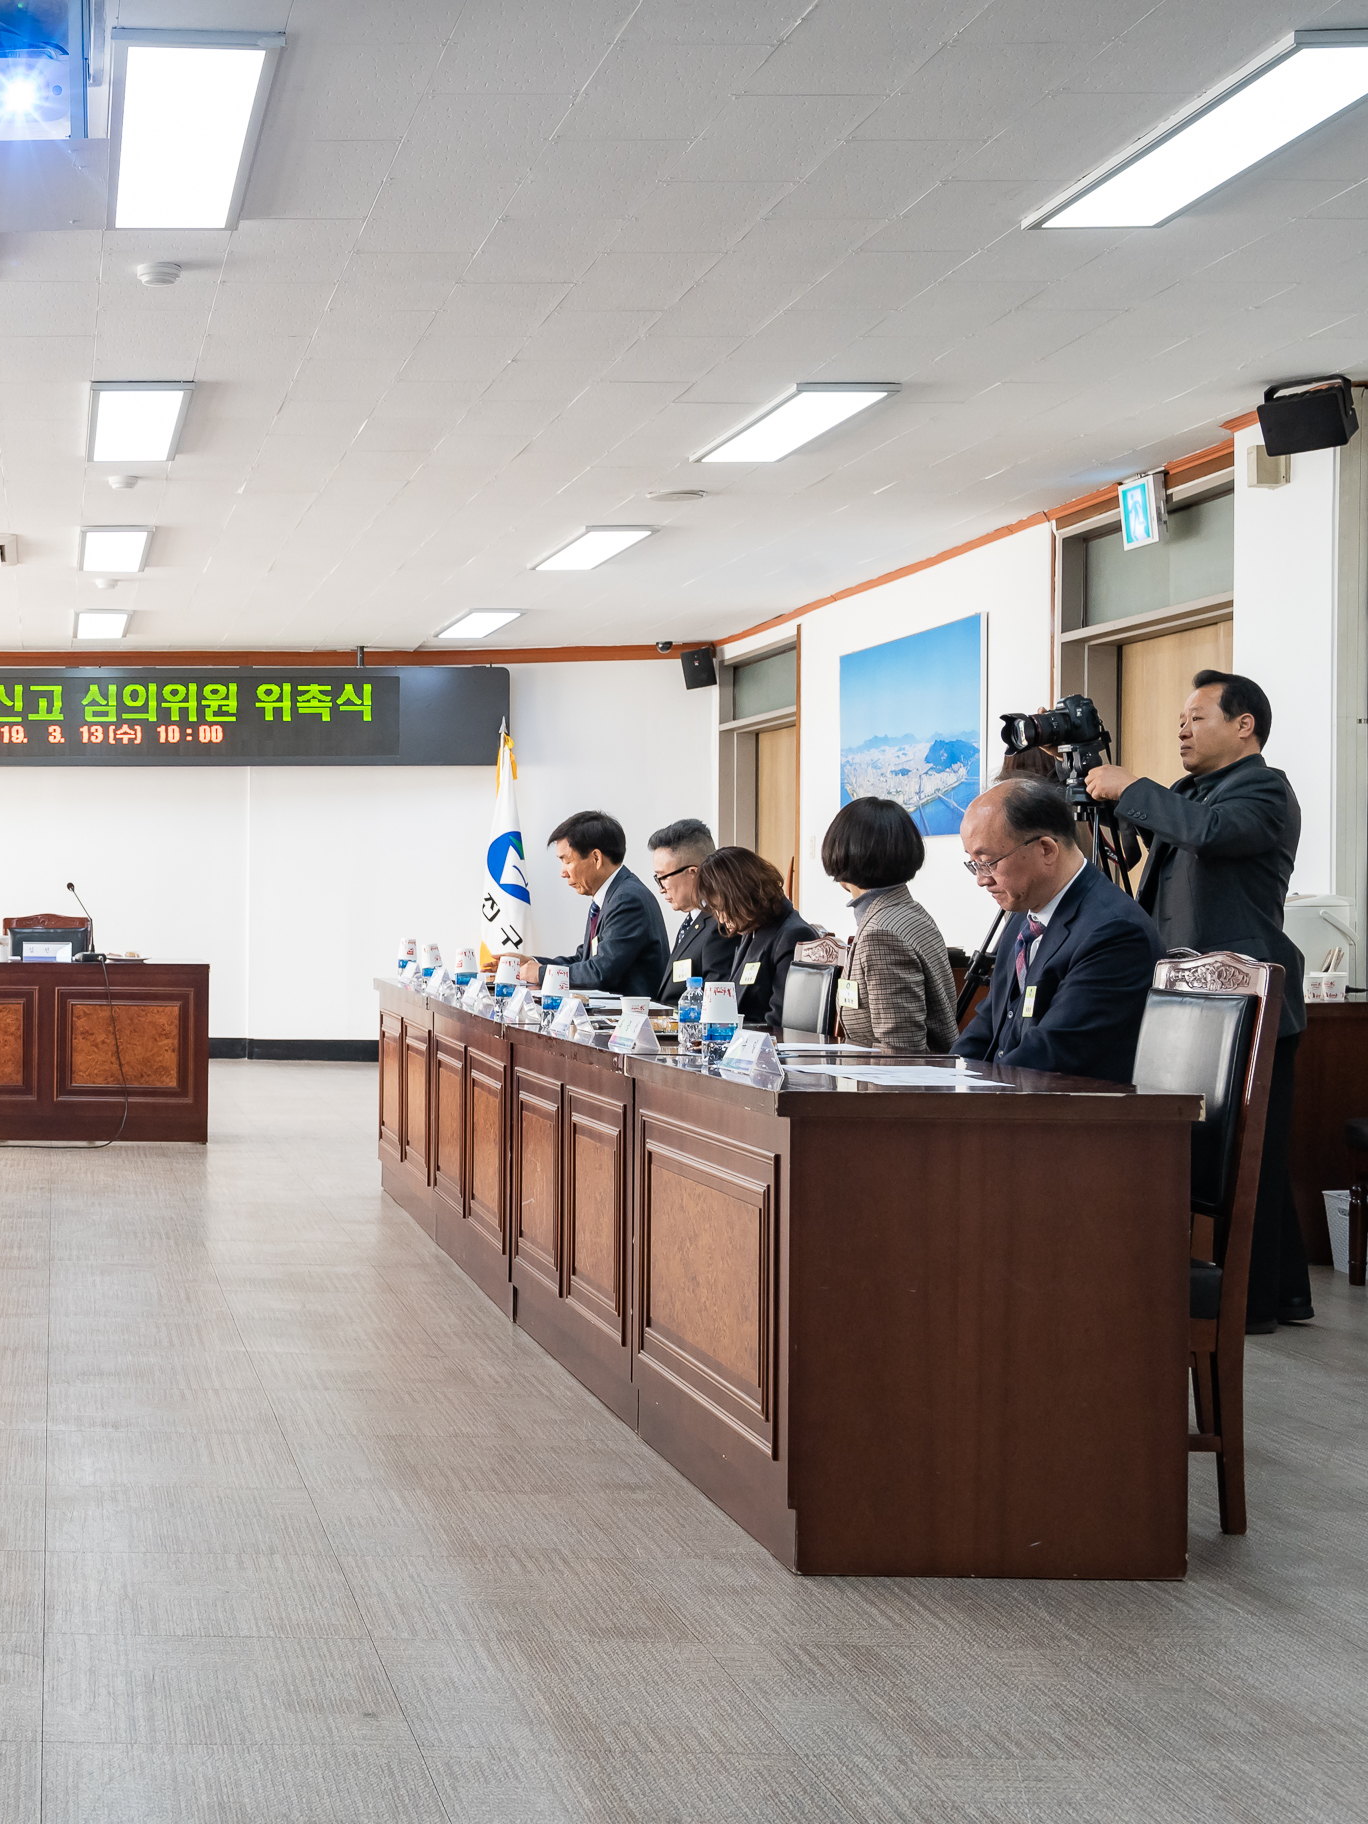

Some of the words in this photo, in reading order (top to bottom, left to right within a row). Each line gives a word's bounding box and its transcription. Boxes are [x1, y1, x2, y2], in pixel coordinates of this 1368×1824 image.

[81, 682, 238, 723] 심의위원
[254, 682, 373, 722] 위촉식
[47, 724, 66, 744] 3.
